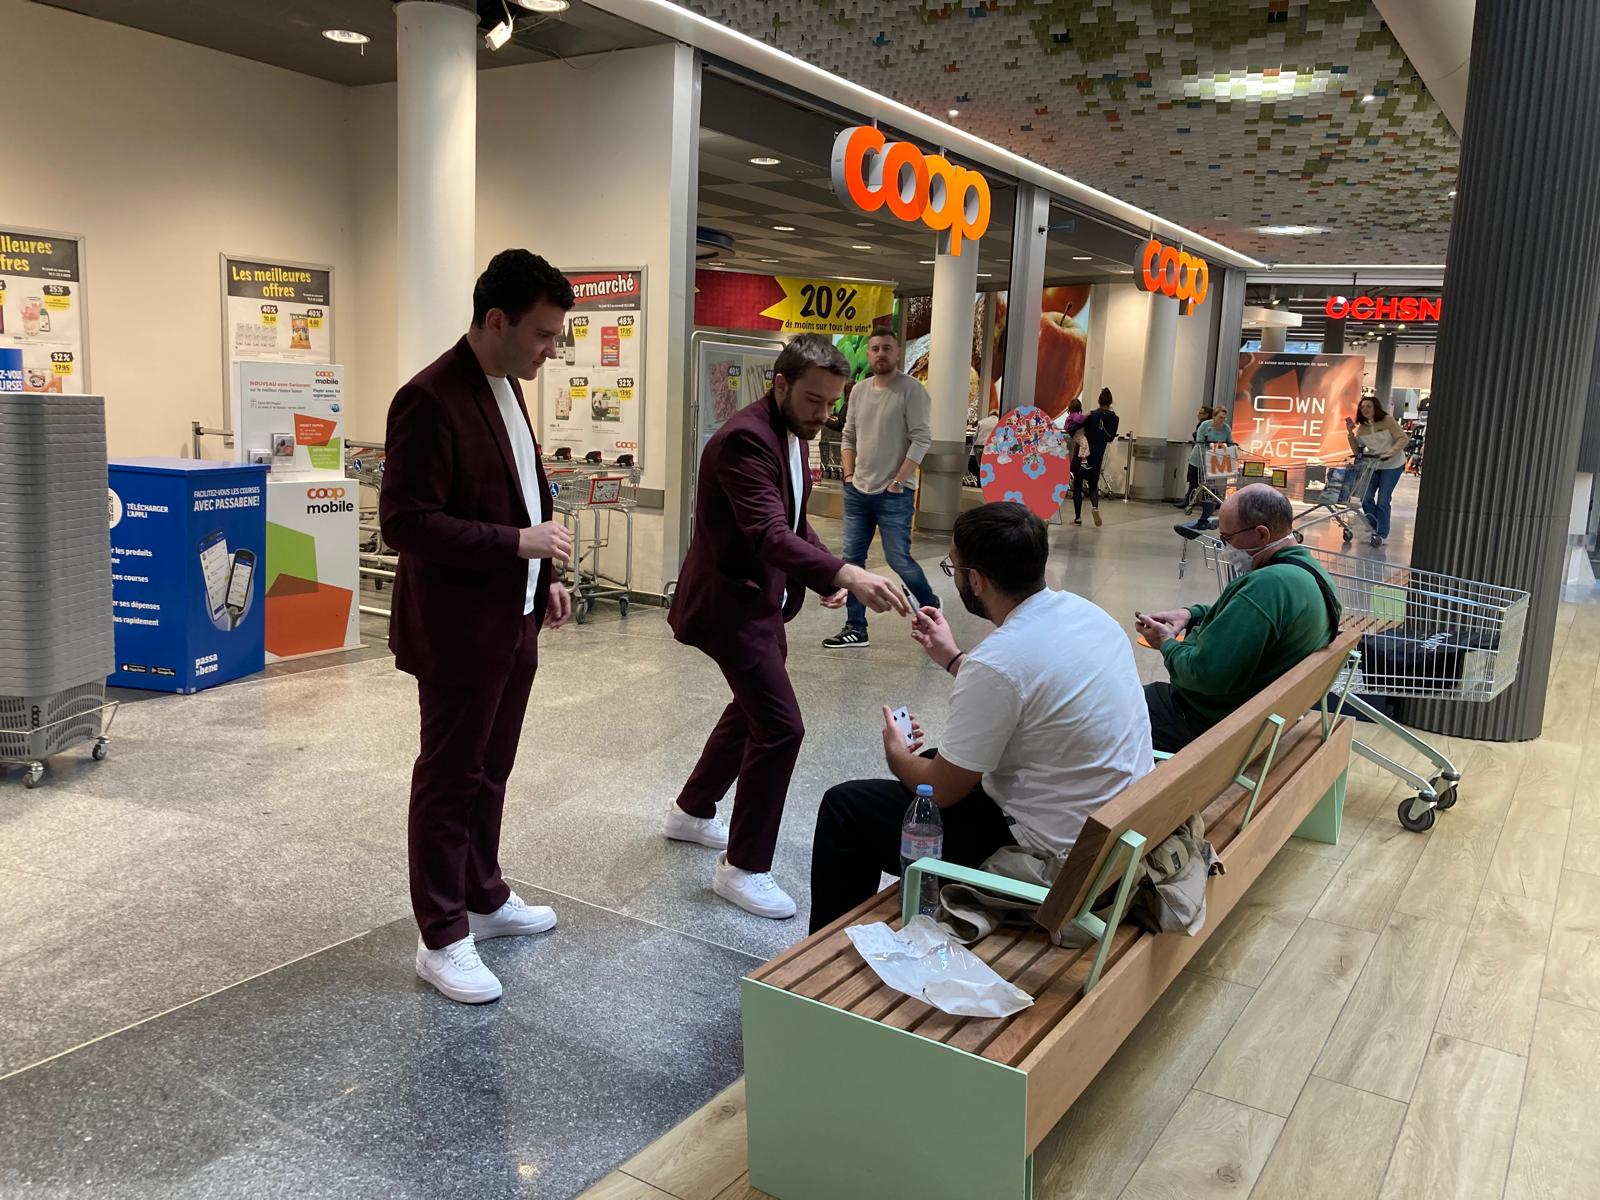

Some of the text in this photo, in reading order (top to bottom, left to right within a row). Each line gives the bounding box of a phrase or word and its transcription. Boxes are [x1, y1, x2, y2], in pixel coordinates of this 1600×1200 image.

[835, 125, 991, 257] coop
[232, 266, 312, 283] Les meilleures
[1138, 239, 1209, 317] coop
[262, 283, 295, 297] offres
[799, 283, 858, 320] 20%
[1325, 295, 1442, 320] OCHSN
[262, 306, 277, 314] 40%
[784, 320, 793, 329] de
[794, 321, 814, 331] moins
[816, 323, 827, 331] sur
[829, 322, 843, 332] tous
[843, 323, 853, 332] les
[52, 353, 71, 362] 32%
[315, 370, 335, 379] coop
[618, 378, 632, 387] 32%
[1253, 395, 1326, 415] OWN
[1252, 417, 1323, 437] THE
[616, 441, 637, 451] coop
[1249, 440, 1321, 460] PACE
[1210, 454, 1233, 474] M
[231, 486, 240, 496] LES
[239, 485, 260, 495] COURSES
[307, 487, 345, 500] coop
[126, 502, 169, 513] TÉLÉCHARGER
[193, 495, 260, 512] AVEC PASSABENE!
[306, 500, 354, 514] mobile
[115, 547, 125, 555] les
[125, 548, 153, 557] produits
[124, 575, 149, 583] courses
[131, 600, 161, 610] dépenses
[124, 617, 159, 626] rapidement
[195, 653, 218, 669] passa
[199, 663, 218, 675] bene
